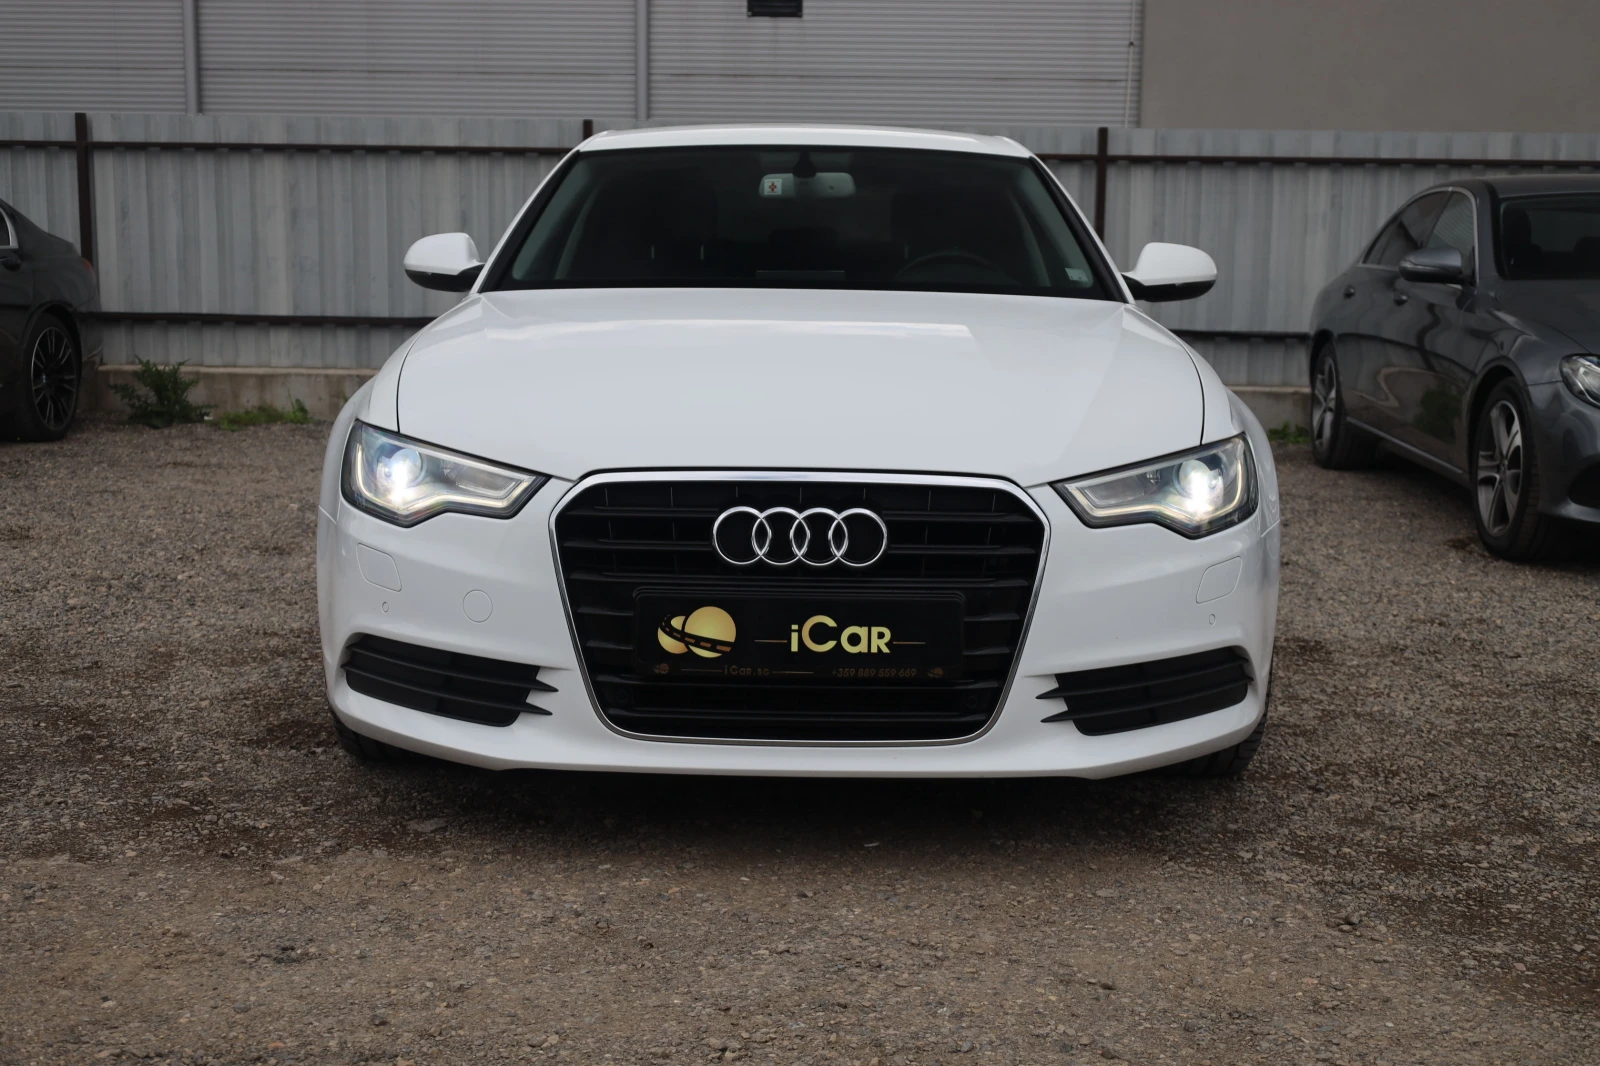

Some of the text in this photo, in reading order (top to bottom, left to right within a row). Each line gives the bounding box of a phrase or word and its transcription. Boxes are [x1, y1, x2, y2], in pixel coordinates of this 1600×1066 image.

[832, 668, 917, 677] +359 889 559 669
